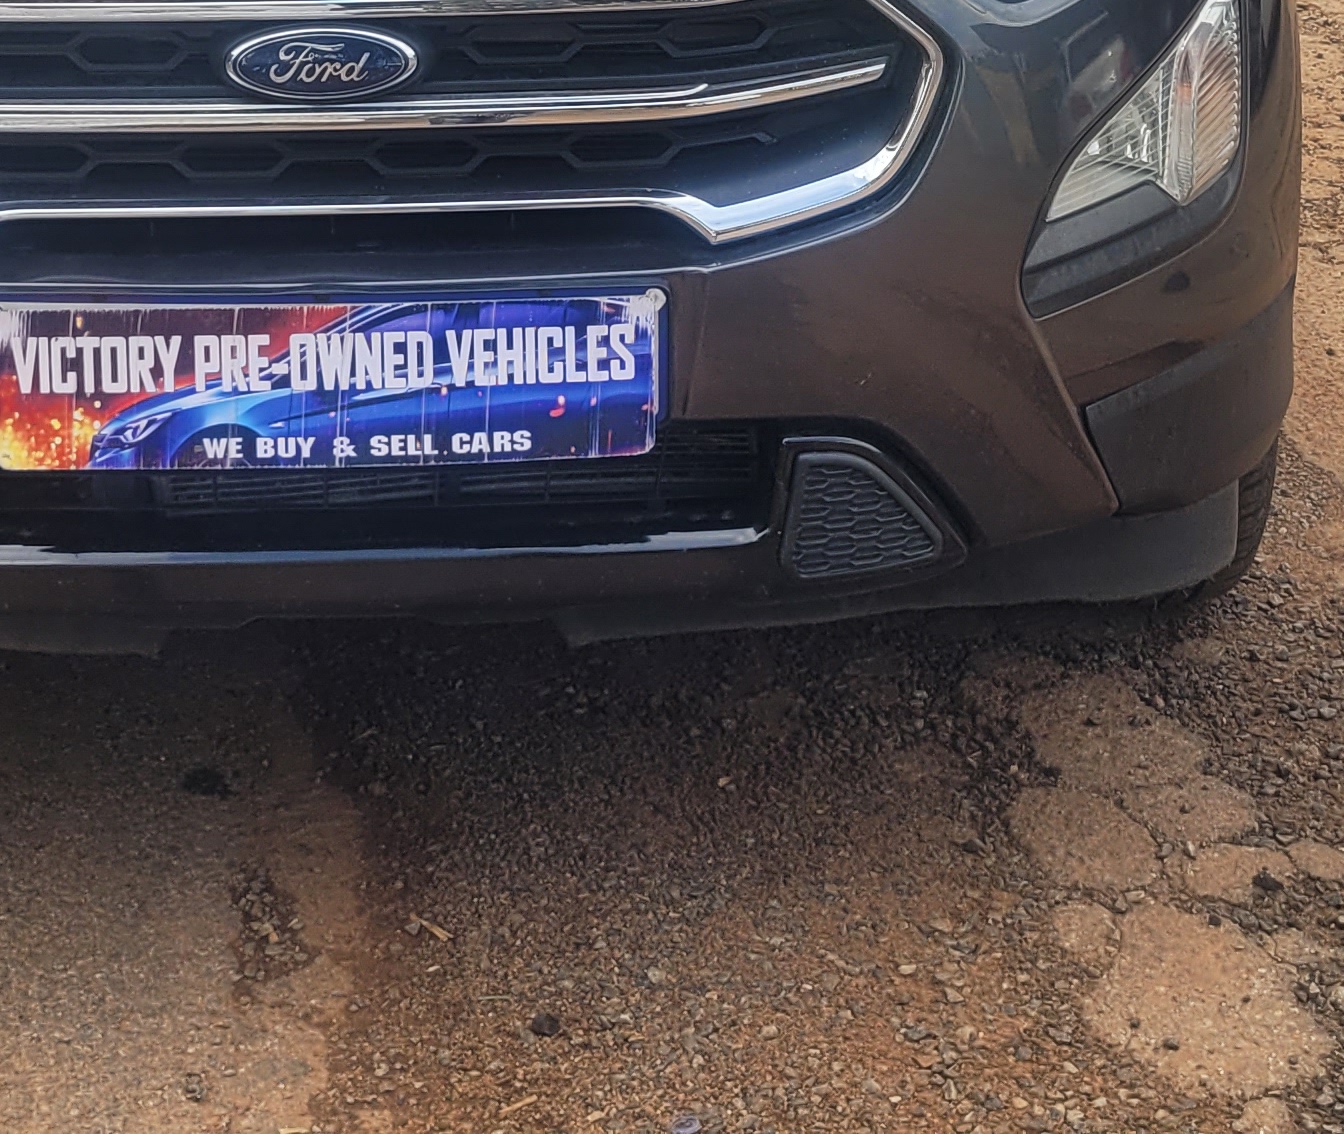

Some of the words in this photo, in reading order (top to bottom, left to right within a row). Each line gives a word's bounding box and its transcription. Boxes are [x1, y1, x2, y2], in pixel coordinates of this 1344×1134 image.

[268, 41, 371, 84] Ford
[12, 334, 183, 395] VICTORY
[193, 330, 435, 393] PRE-OWNED
[445, 323, 636, 388] VEHICLES
[202, 437, 244, 459] WE
[256, 436, 317, 459] BUY
[332, 436, 357, 458] &
[369, 433, 439, 457] SELL
[451, 429, 533, 455] CARS
